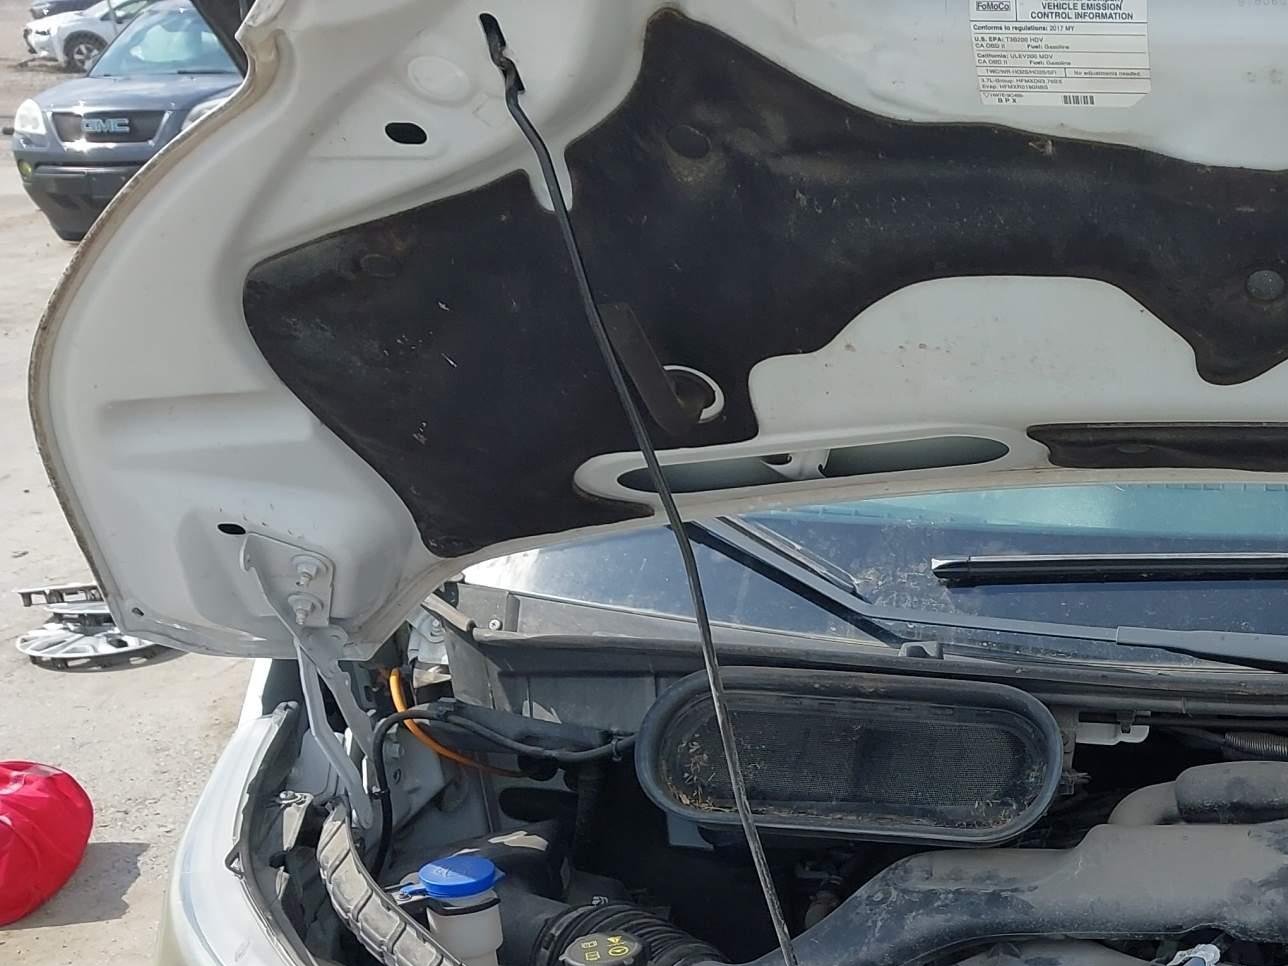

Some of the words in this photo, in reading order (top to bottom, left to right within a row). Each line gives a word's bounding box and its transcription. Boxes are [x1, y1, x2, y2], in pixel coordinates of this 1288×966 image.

[978, 1, 1010, 11] FoMoCo
[1081, 3, 1122, 11] EMISSION
[1031, 12, 1072, 20] CONTROL
[1074, 12, 1133, 20] INFORMATION
[1012, 25, 1048, 33] regulations:
[81, 117, 130, 133] GMC
